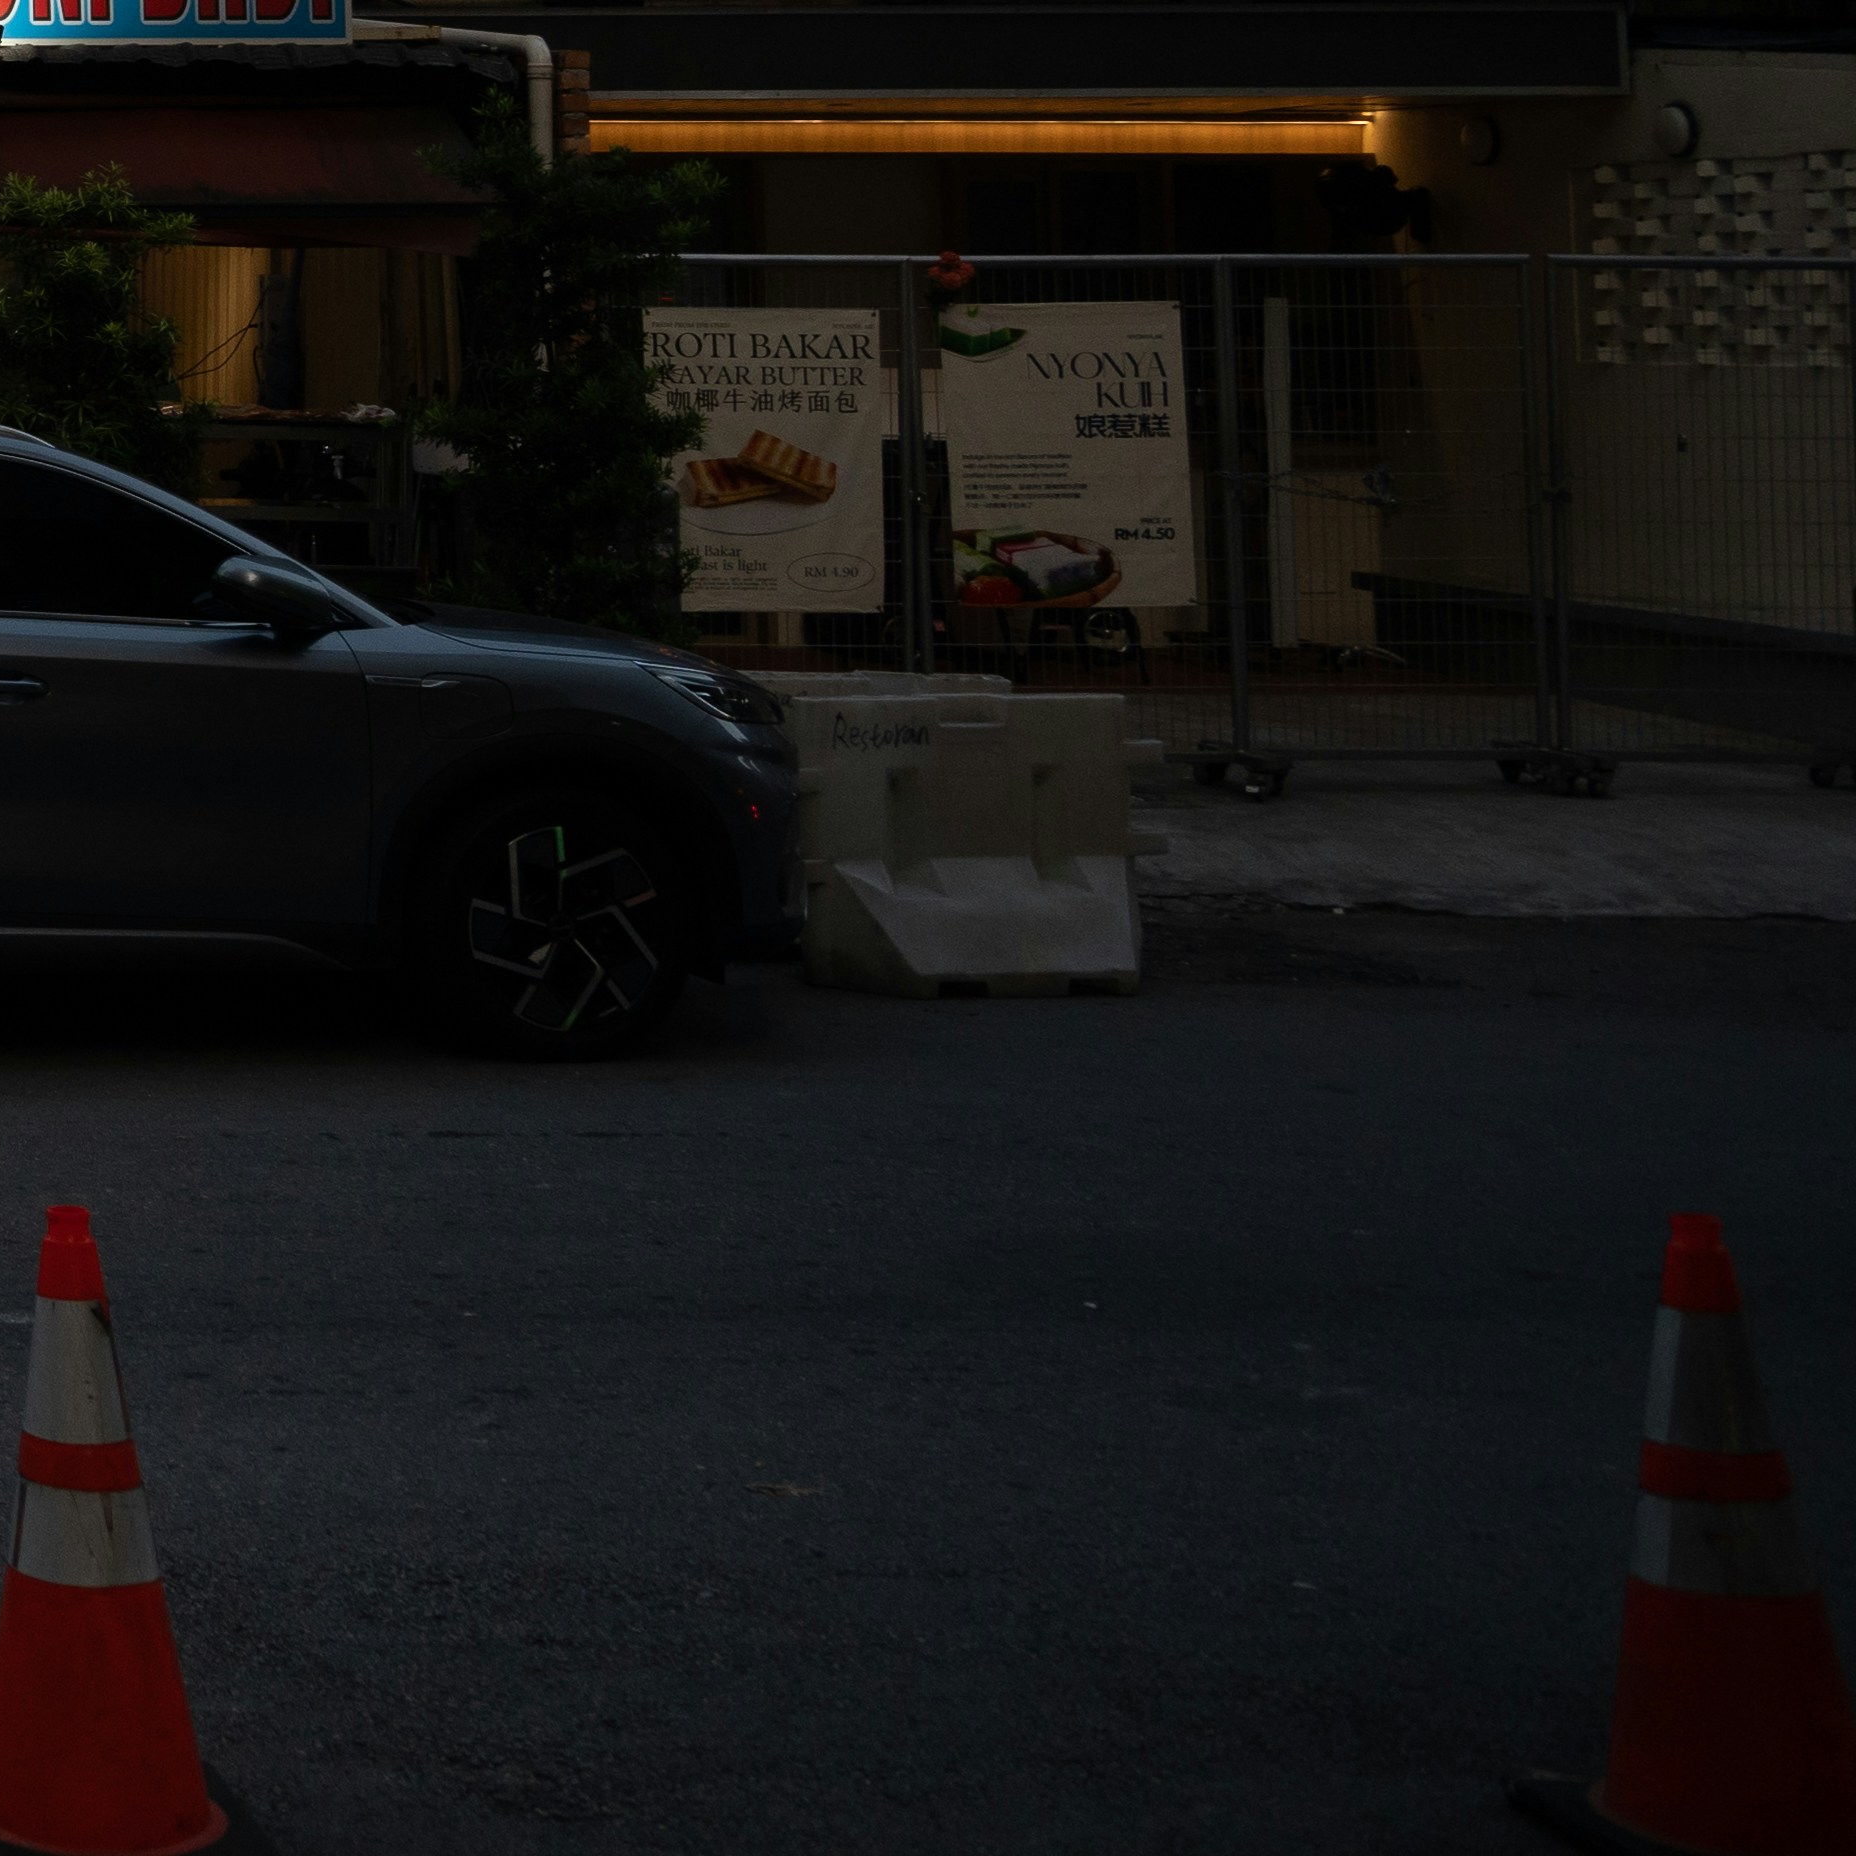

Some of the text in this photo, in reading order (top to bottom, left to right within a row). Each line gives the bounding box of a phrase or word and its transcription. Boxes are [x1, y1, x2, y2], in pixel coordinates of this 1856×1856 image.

[651, 332, 876, 360] ROTI BAKAR
[761, 366, 868, 386] BUTTER
[1026, 351, 1167, 380] NYONYA
[1096, 381, 1169, 408] KUIH
[1075, 413, 1171, 439] 娘惹糕
[1114, 527, 1175, 540] RM 4.50
[704, 544, 743, 557] Bakar
[722, 559, 734, 570] is
[737, 559, 768, 574] light
[804, 566, 859, 578] RM 4.90
[831, 711, 931, 753] Restoran
